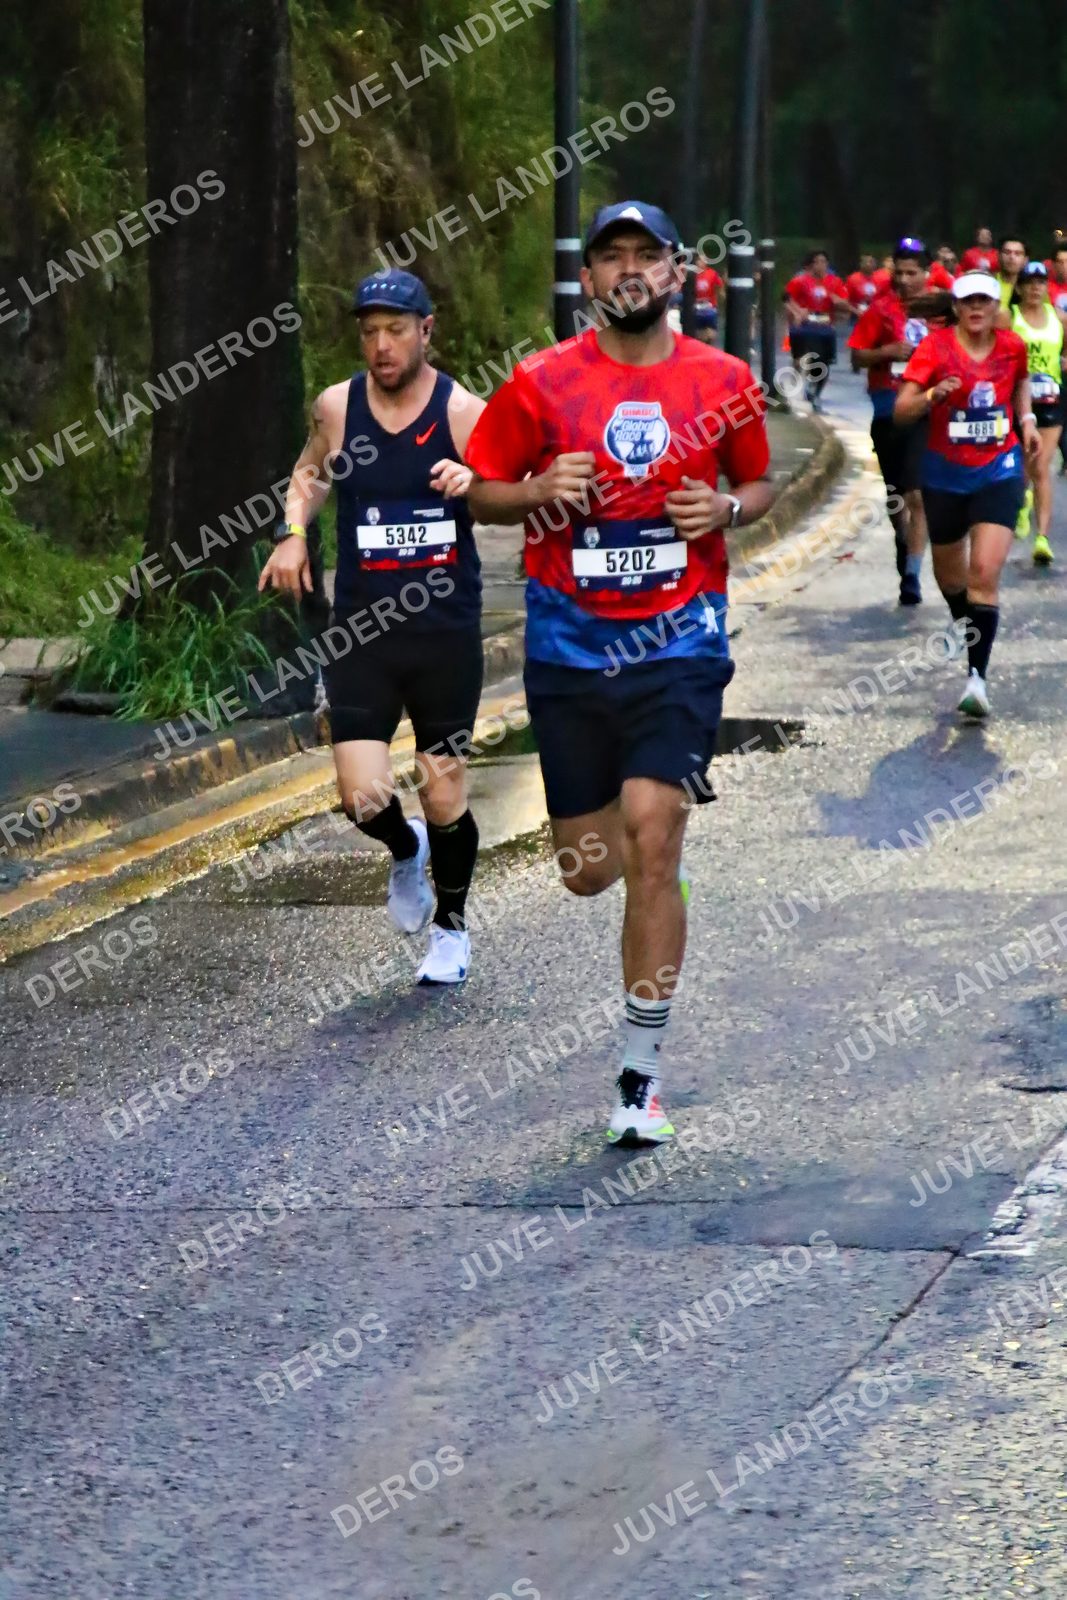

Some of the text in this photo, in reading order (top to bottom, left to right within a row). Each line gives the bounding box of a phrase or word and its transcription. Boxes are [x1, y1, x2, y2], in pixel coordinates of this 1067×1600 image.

[622, 420, 655, 432] Global
[615, 430, 640, 440] Race
[386, 524, 427, 545] 5342
[606, 548, 656, 572] 5202
